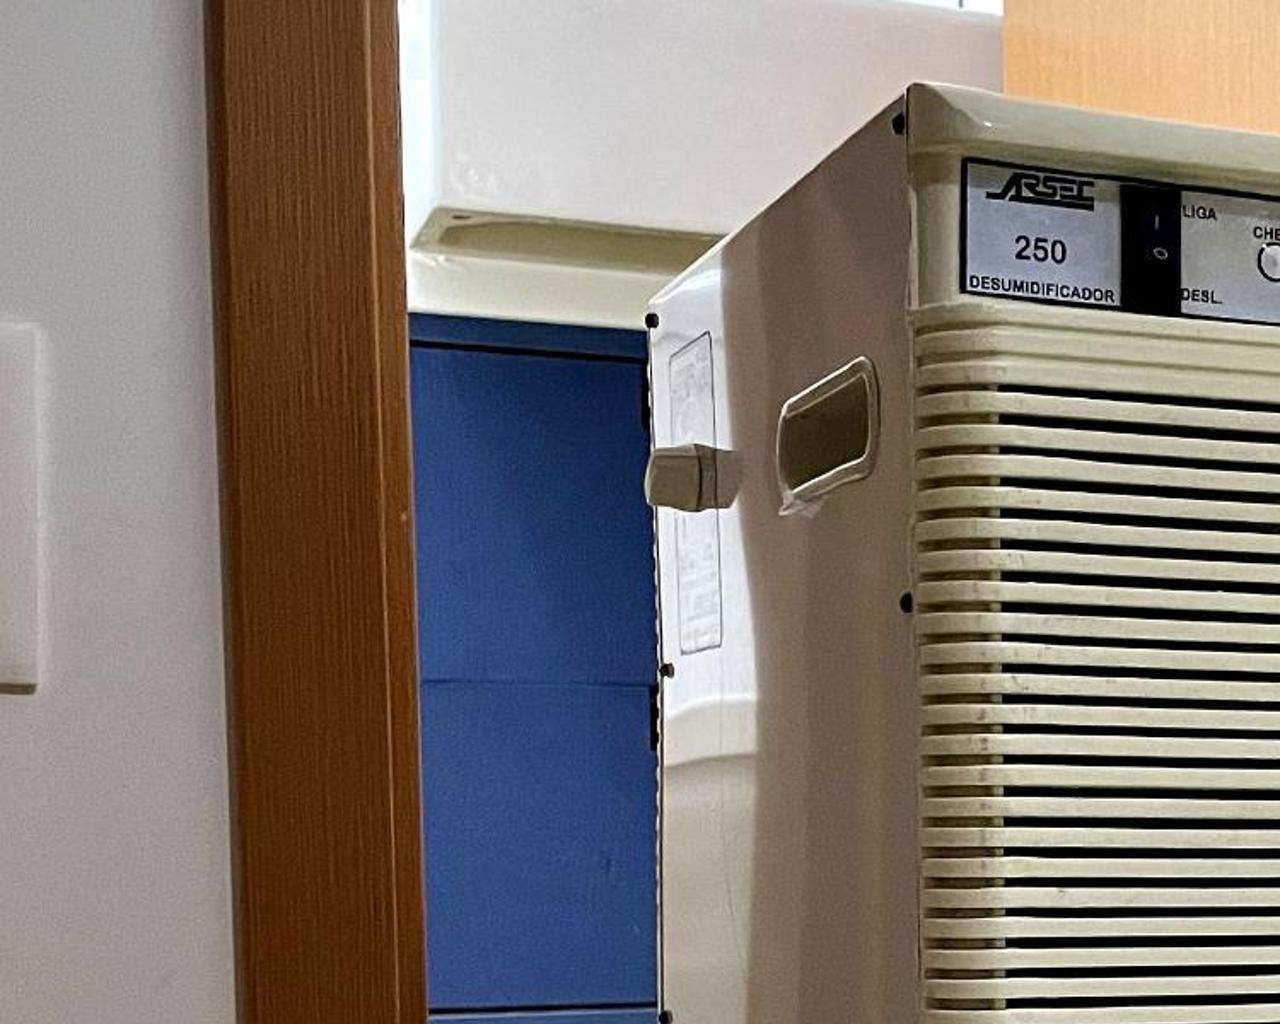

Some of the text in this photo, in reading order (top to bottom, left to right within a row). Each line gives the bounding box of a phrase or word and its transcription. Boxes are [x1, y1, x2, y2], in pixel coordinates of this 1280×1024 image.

[986, 172, 1095, 211] ARSEC
[1182, 205, 1217, 221] LIGA
[1014, 235, 1067, 265] 250
[968, 275, 1116, 303] DESUMIDIFICADOR
